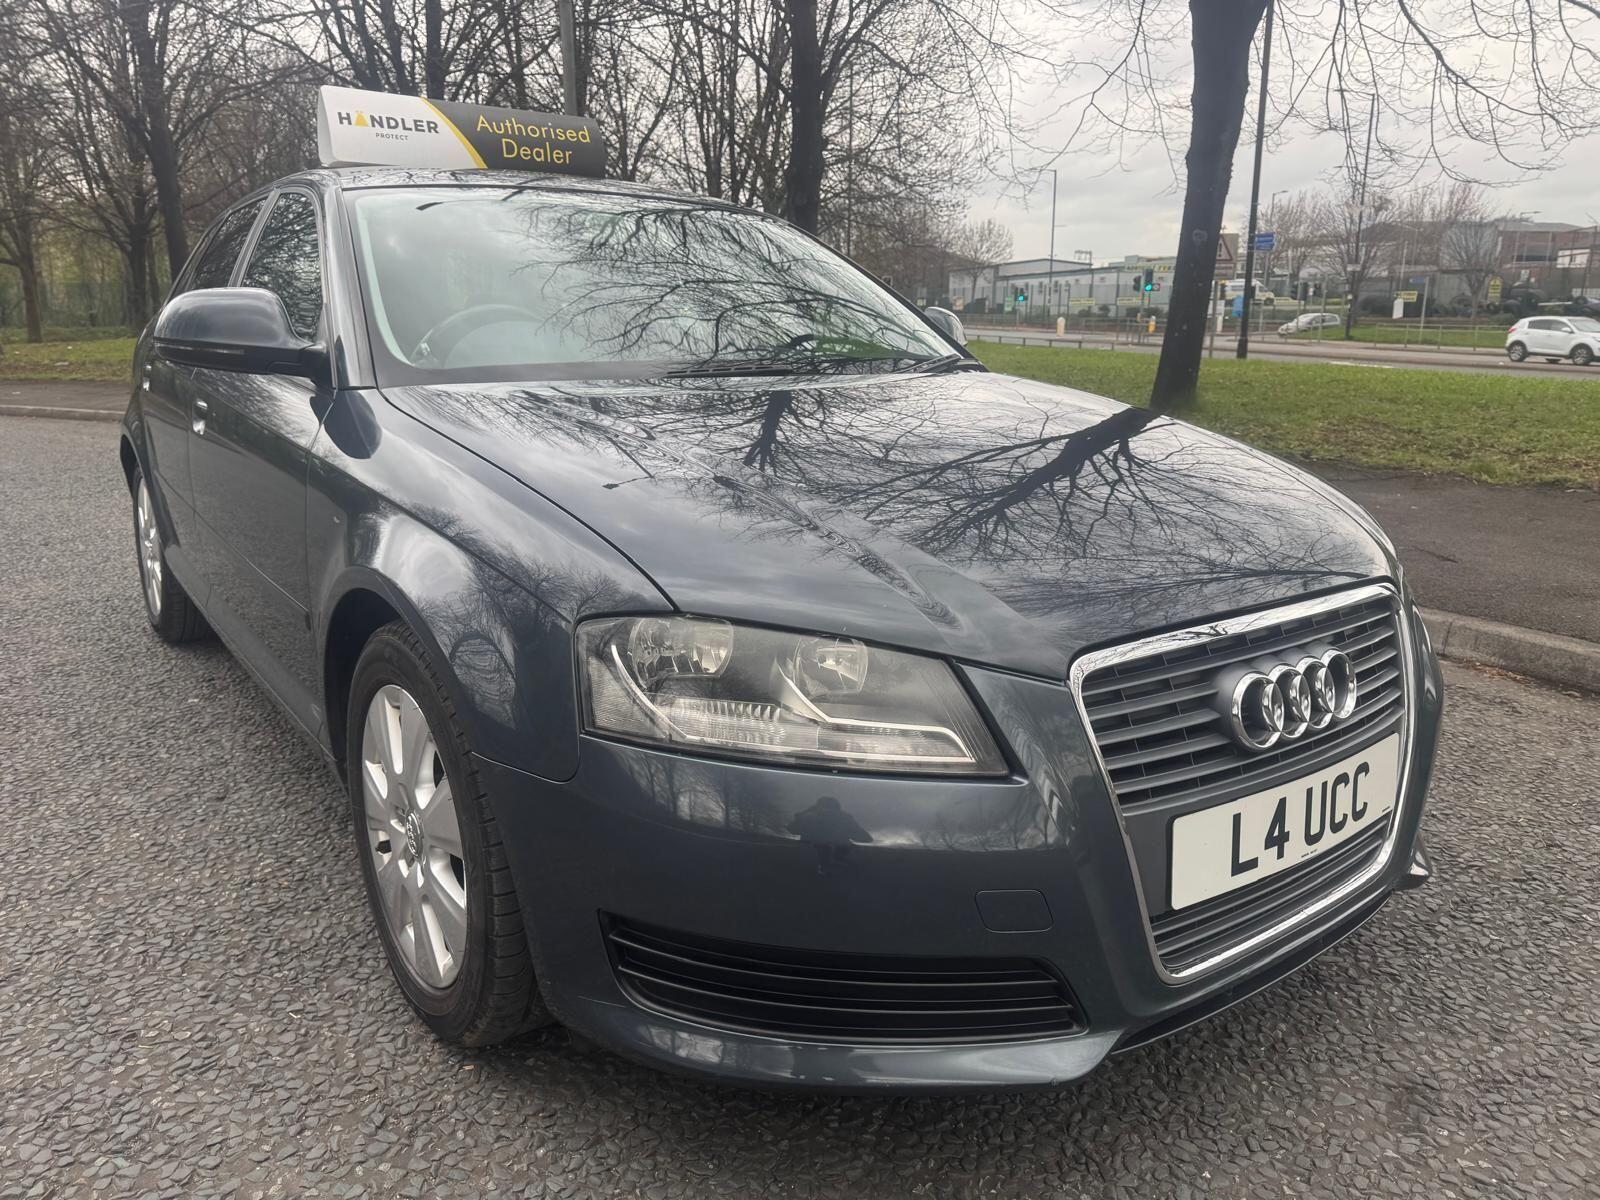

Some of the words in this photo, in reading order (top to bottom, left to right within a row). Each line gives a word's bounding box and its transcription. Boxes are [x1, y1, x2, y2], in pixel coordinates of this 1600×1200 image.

[375, 132, 409, 141] PROTECT
[476, 115, 591, 143] Authorised
[501, 138, 573, 164] Dealer
[1231, 796, 1290, 878] L4
[1304, 761, 1370, 847] UCC
